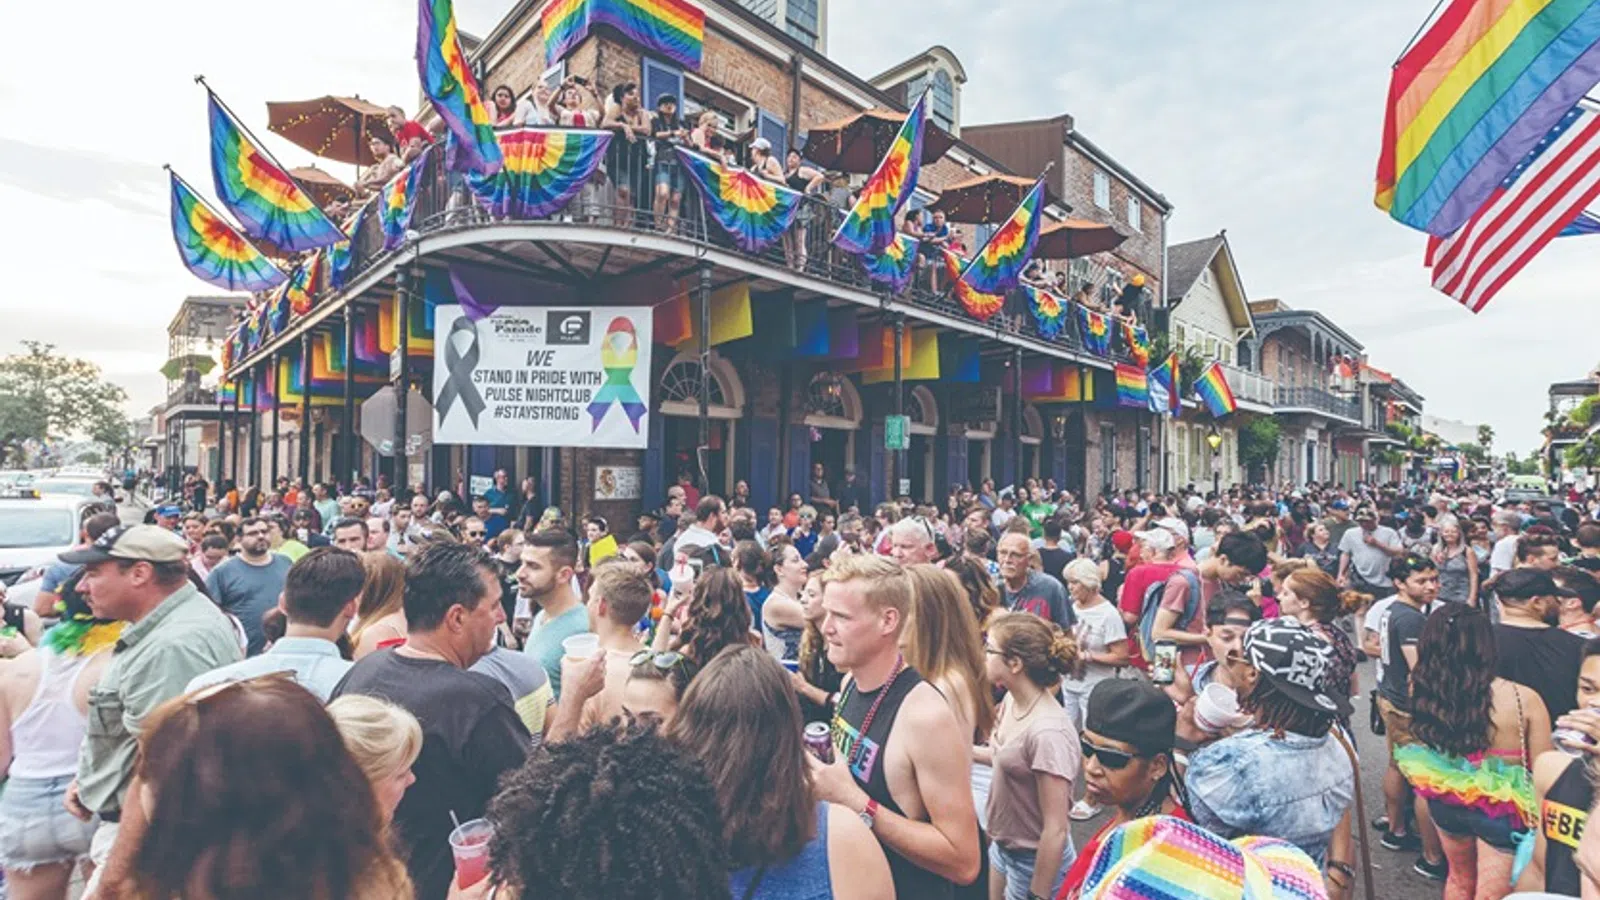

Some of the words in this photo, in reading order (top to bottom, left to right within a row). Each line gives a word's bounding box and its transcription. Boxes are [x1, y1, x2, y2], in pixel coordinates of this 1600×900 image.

[495, 325, 542, 334] Parade
[526, 350, 556, 367] WE
[474, 369, 512, 383] STAND
[515, 370, 528, 384] IN
[531, 370, 566, 385] PRIDE
[569, 371, 602, 385] WITH
[485, 386, 522, 402] PULSE
[526, 388, 592, 403] NIGHTCLUB
[493, 405, 579, 421] #STAYSTRONG
